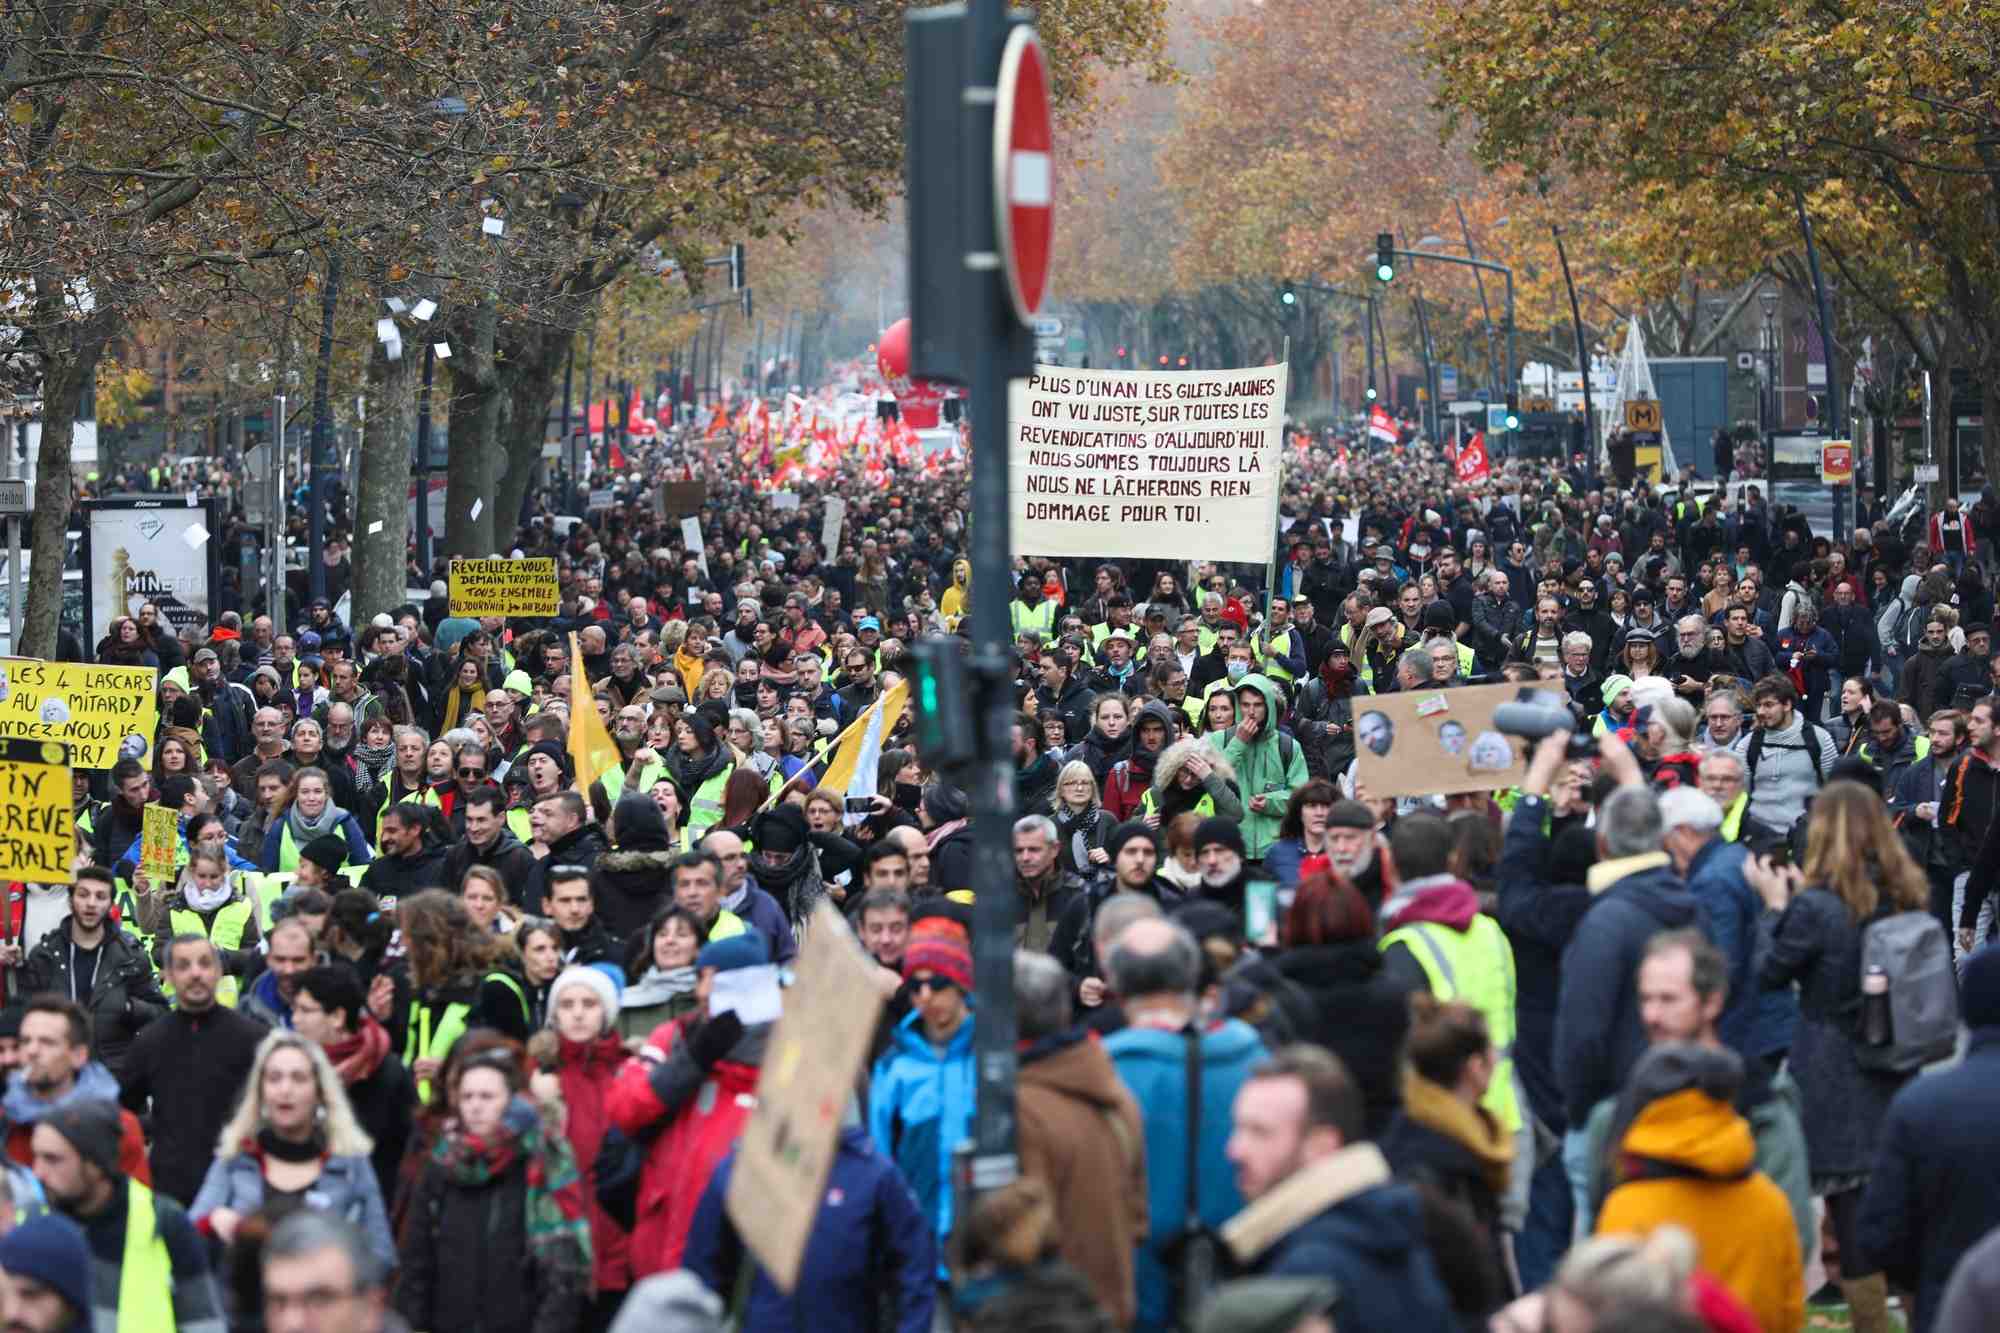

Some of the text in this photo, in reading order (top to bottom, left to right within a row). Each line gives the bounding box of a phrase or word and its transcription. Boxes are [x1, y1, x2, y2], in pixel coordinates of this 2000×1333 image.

[1028, 375, 1071, 394] PLUS
[1145, 384, 1172, 399] LES
[1176, 383, 1222, 399] GILETS
[1225, 379, 1275, 397] JAUNES
[1032, 400, 1061, 418] ONT
[1069, 403, 1089, 420] VU
[1183, 404, 1239, 421] TOUTES
[1243, 403, 1269, 419] LES
[1020, 426, 1269, 449] REVENDICATIONS D'AUJOURD'HUI.
[1029, 451, 1261, 473] NOUS SOMMES TOUJOURS LÀ
[1027, 475, 1251, 497] NOUS NE LÂCHERONS RIEN
[1026, 503, 1209, 523] DOMMAGE POUR TOI.
[460, 575, 558, 585] DEMAIN TROP TARD
[465, 587, 553, 599] TOUS ENSEMBLE
[11, 667, 153, 691] LES 4 LASCARS
[12, 691, 38, 712] AU
[120, 723, 138, 738] LE
[0, 763, 48, 798] IN
[0, 801, 72, 838] RÈVE
